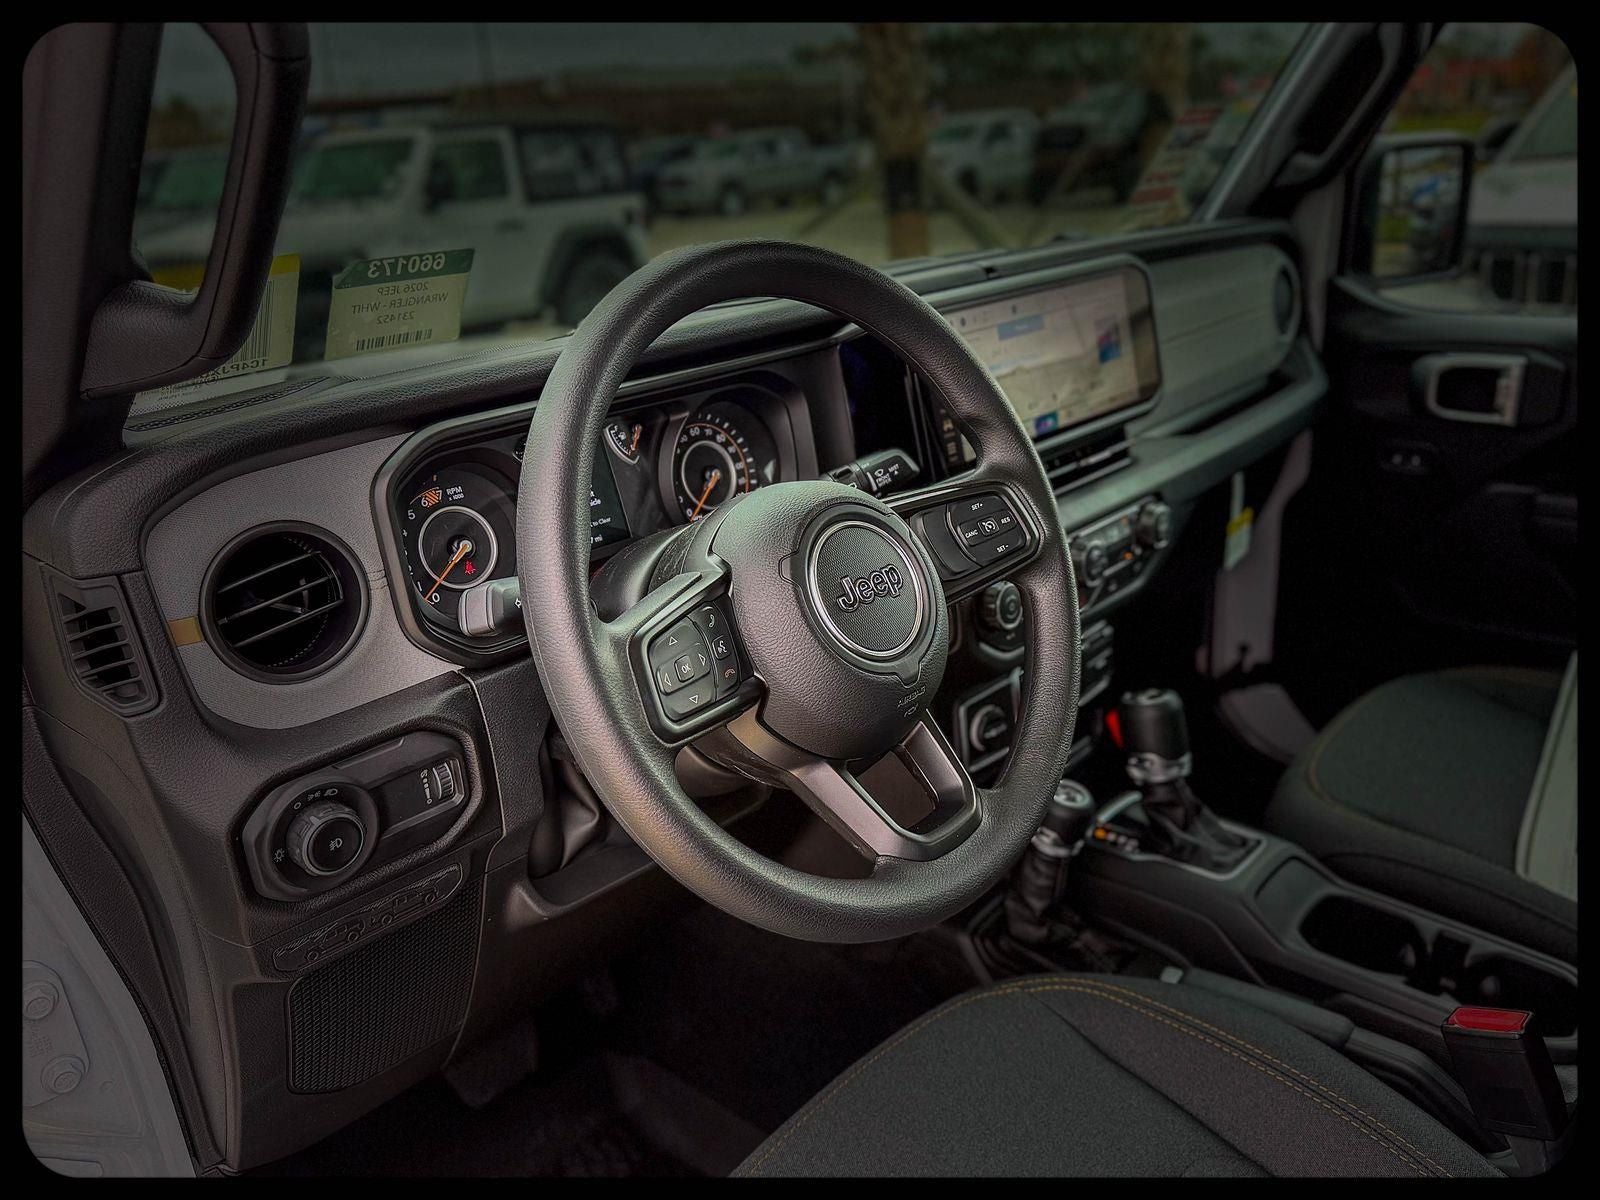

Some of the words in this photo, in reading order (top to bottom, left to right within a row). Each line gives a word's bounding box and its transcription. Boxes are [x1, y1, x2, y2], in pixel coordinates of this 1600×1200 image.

[446, 485, 462, 496] RPM
[420, 497, 429, 508] 6
[407, 509, 416, 520] 5
[964, 529, 979, 539] CANC
[837, 563, 904, 613] Jeep
[431, 592, 441, 603] 0
[680, 662, 692, 674] OK
